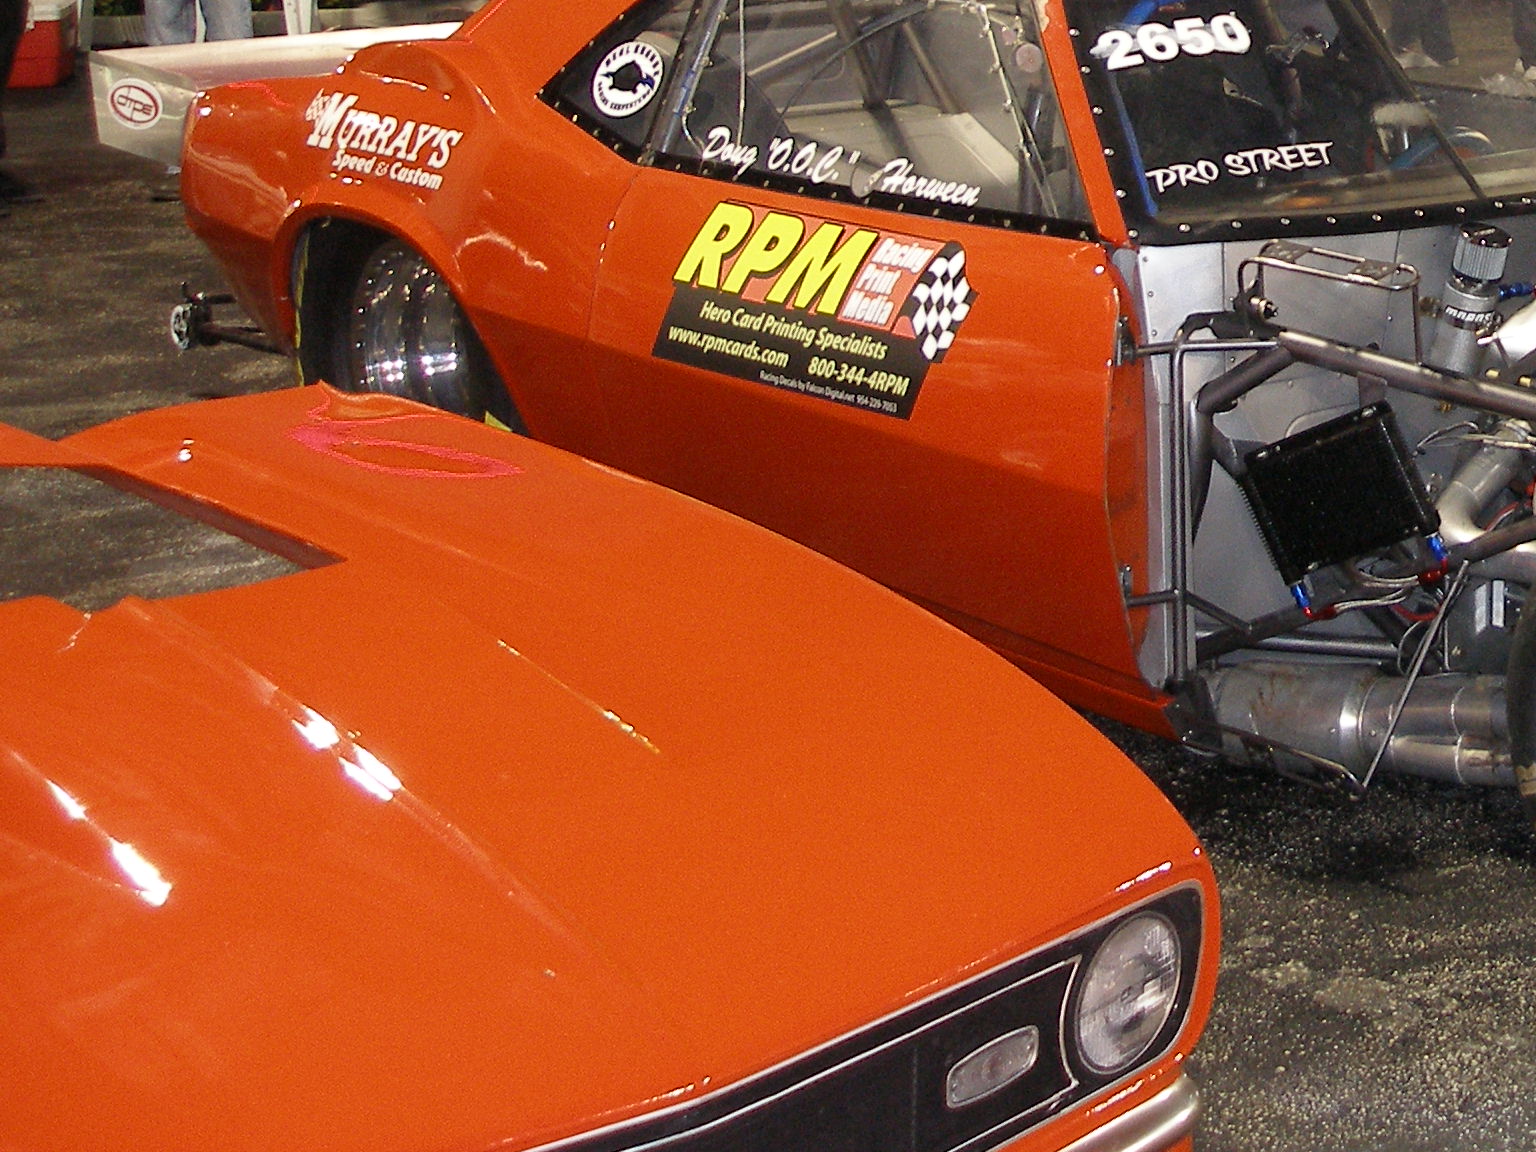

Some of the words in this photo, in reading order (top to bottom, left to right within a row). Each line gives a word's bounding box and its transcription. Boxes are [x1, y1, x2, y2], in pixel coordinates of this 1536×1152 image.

[1096, 14, 1251, 70] 2650
[307, 91, 464, 169] MURRAY'S
[332, 149, 377, 174] Speed
[374, 161, 390, 177] &
[389, 161, 444, 191] Custom
[702, 125, 760, 179] Doug
[880, 157, 982, 207] Horween
[1145, 159, 1220, 193] PRO
[1224, 141, 1334, 177] STREET
[673, 201, 879, 316] RPM
[856, 262, 902, 296] Print
[871, 237, 934, 274] Racing
[699, 300, 731, 323] Hero
[732, 307, 766, 330] Card
[762, 314, 816, 348] Printing
[815, 326, 888, 360] Specialists
[841, 290, 894, 325] Media
[668, 325, 790, 368] www.rpmcards.com
[807, 356, 910, 396] 800-344-4RPM
